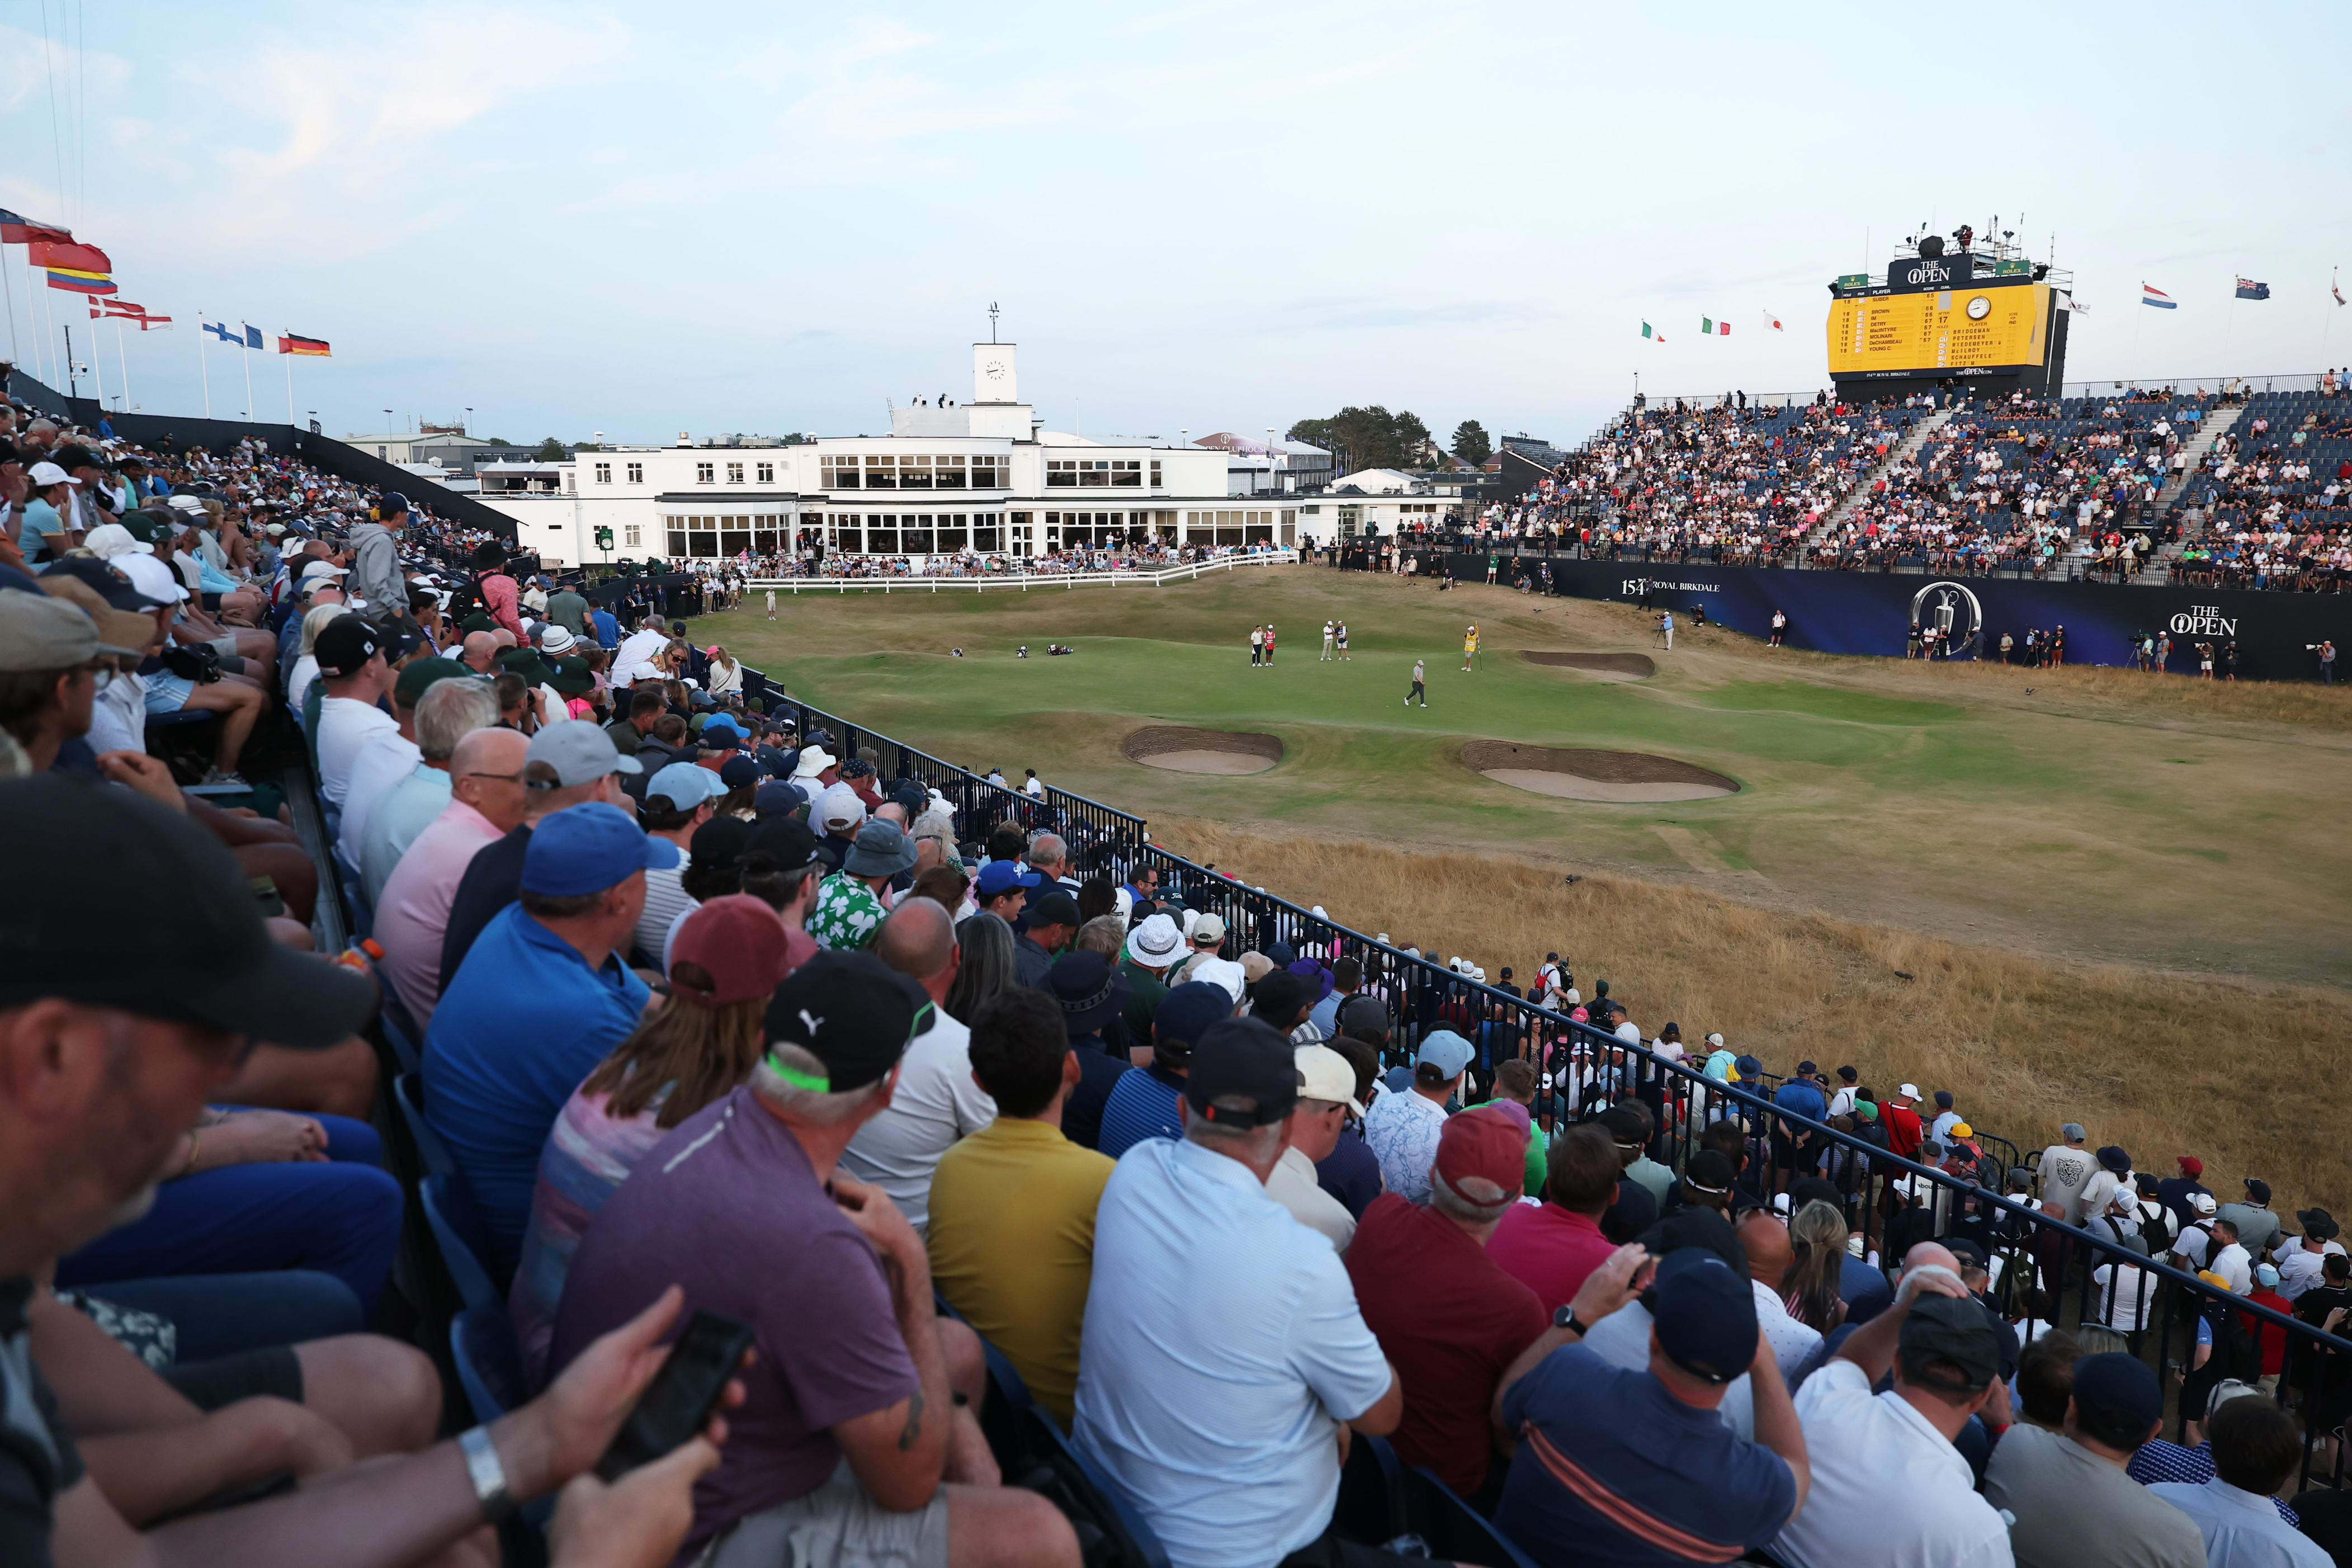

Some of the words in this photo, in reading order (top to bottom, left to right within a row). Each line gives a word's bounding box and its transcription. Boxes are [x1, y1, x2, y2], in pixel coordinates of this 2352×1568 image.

[1920, 261, 1939, 270] THE
[1907, 267, 1951, 284] OPEN
[1652, 581, 1678, 590] ROYAL
[1679, 582, 1720, 592] BIRKDALE
[2191, 605, 2219, 617] THE
[2170, 613, 2238, 636] OPEN
